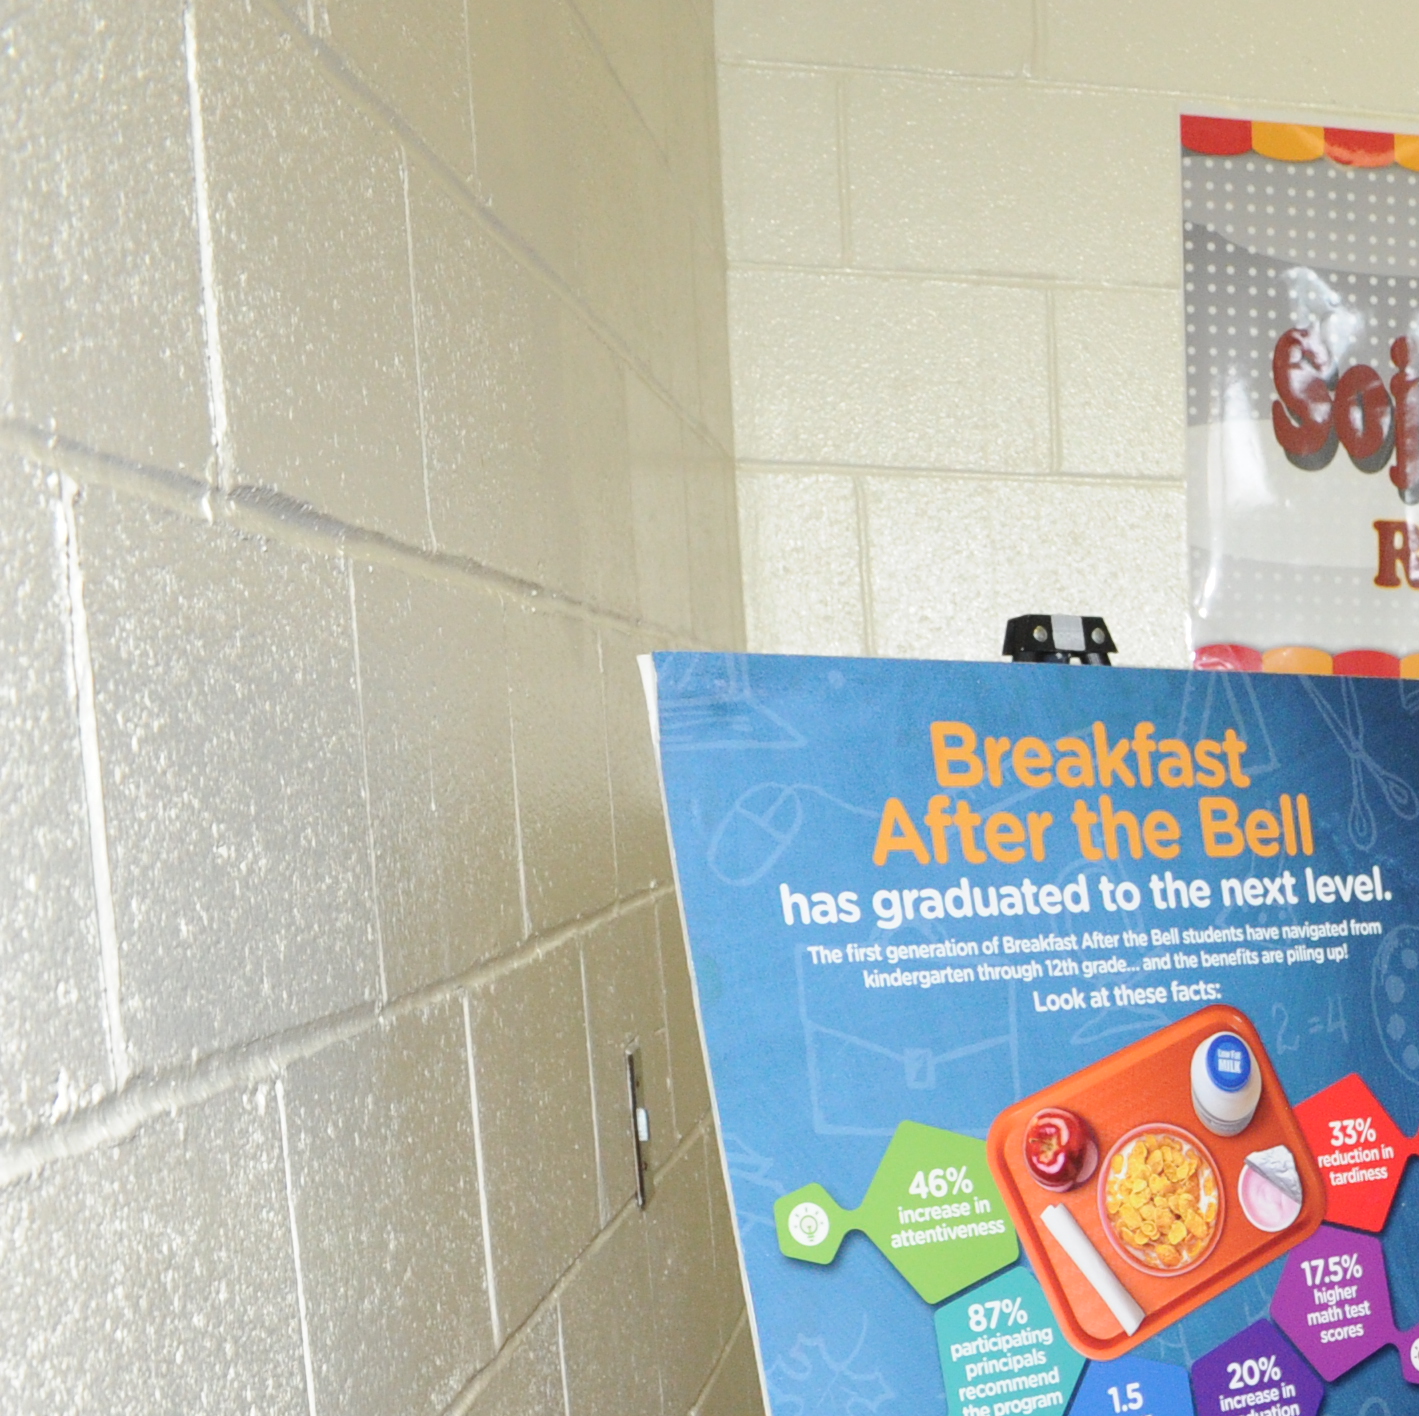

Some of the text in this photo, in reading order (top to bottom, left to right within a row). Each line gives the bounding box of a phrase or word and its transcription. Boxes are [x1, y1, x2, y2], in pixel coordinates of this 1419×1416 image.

[930, 721, 1250, 787] Breakfast
[872, 793, 1315, 866] After the Bell
[780, 865, 1392, 929] has graduated to the next level.
[807, 919, 1382, 965] The first generation of Breakfast After the Bell students have navigated from
[863, 943, 1349, 989] kindergarten through 12th grade... and the benefits are piling up!
[1033, 980, 1222, 1013] Look at these facts:
[1217, 1059, 1242, 1074] MILK
[1328, 1117, 1376, 1147] 33%
[1317, 1144, 1394, 1169] reduction in
[908, 1165, 974, 1199] 46%
[1329, 1166, 1388, 1187] tardiness
[898, 1196, 991, 1225] increase in
[890, 1219, 1006, 1249] attentiveness
[1300, 1253, 1363, 1287] 17.5%
[1313, 1283, 1358, 1306] higher
[967, 1297, 1028, 1332] 87%
[1306, 1300, 1371, 1327] math test
[950, 1326, 1053, 1362] participating
[1320, 1322, 1364, 1344] scores
[965, 1349, 1047, 1382] principals
[1226, 1355, 1282, 1390] 20%
[958, 1367, 1060, 1403] recommend
[1107, 1382, 1144, 1413] 1.5
[1219, 1381, 1296, 1413] increase in
